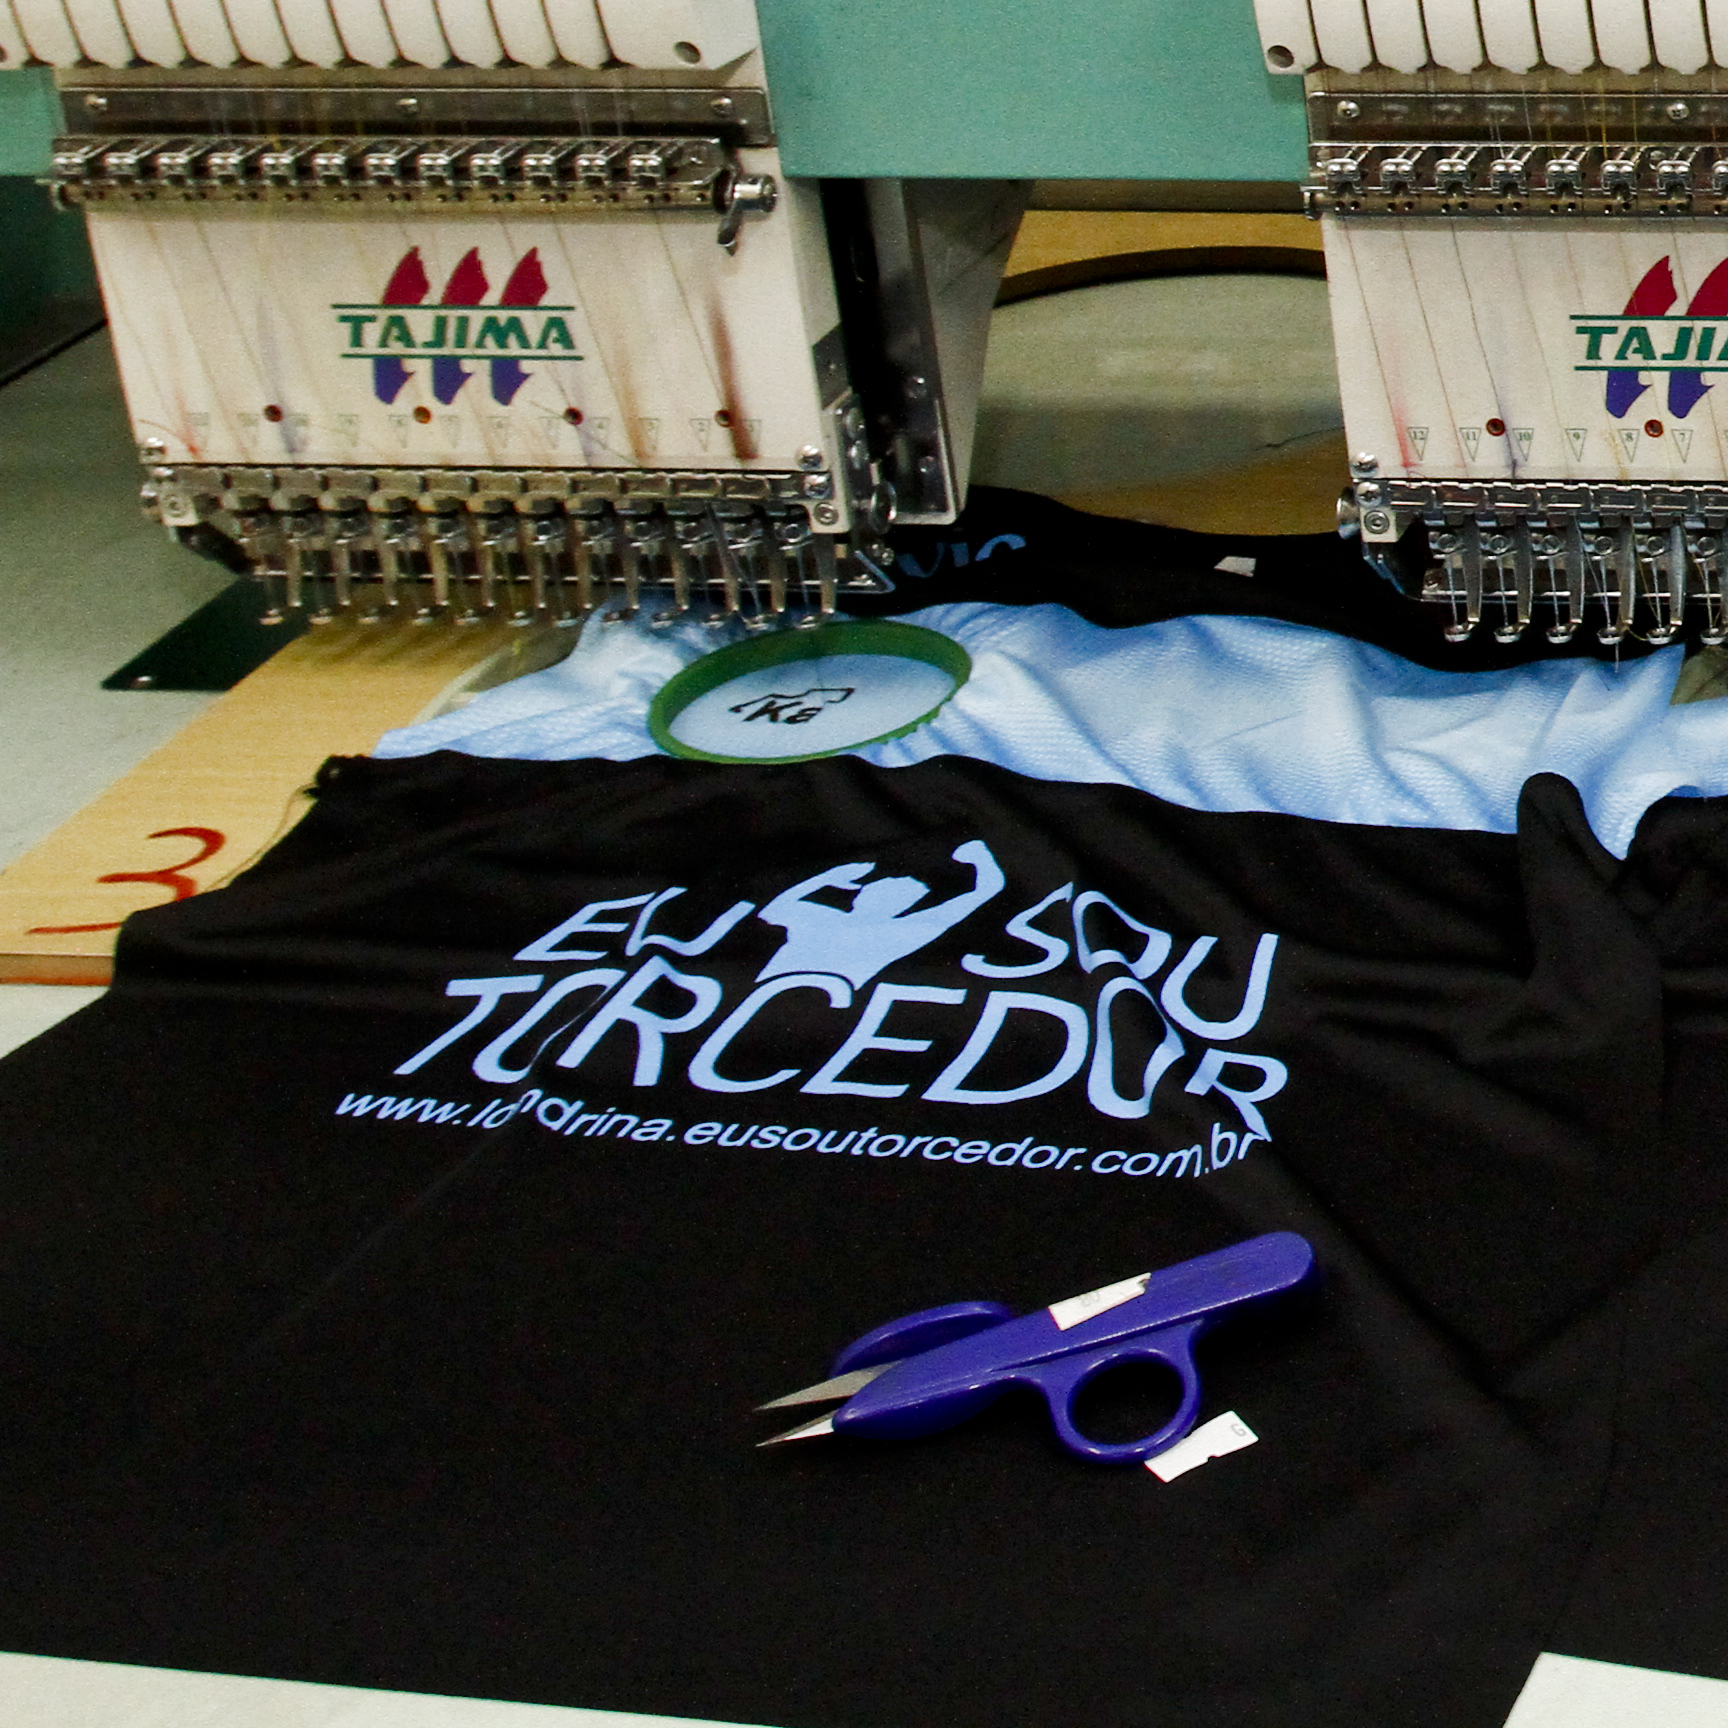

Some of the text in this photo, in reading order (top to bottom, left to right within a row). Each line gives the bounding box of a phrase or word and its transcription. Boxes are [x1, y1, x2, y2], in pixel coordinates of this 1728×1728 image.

[336, 315, 575, 350] TAJIMA
[513, 882, 1278, 1041] EU SOU
[393, 955, 1289, 1142] TORCEDOR
